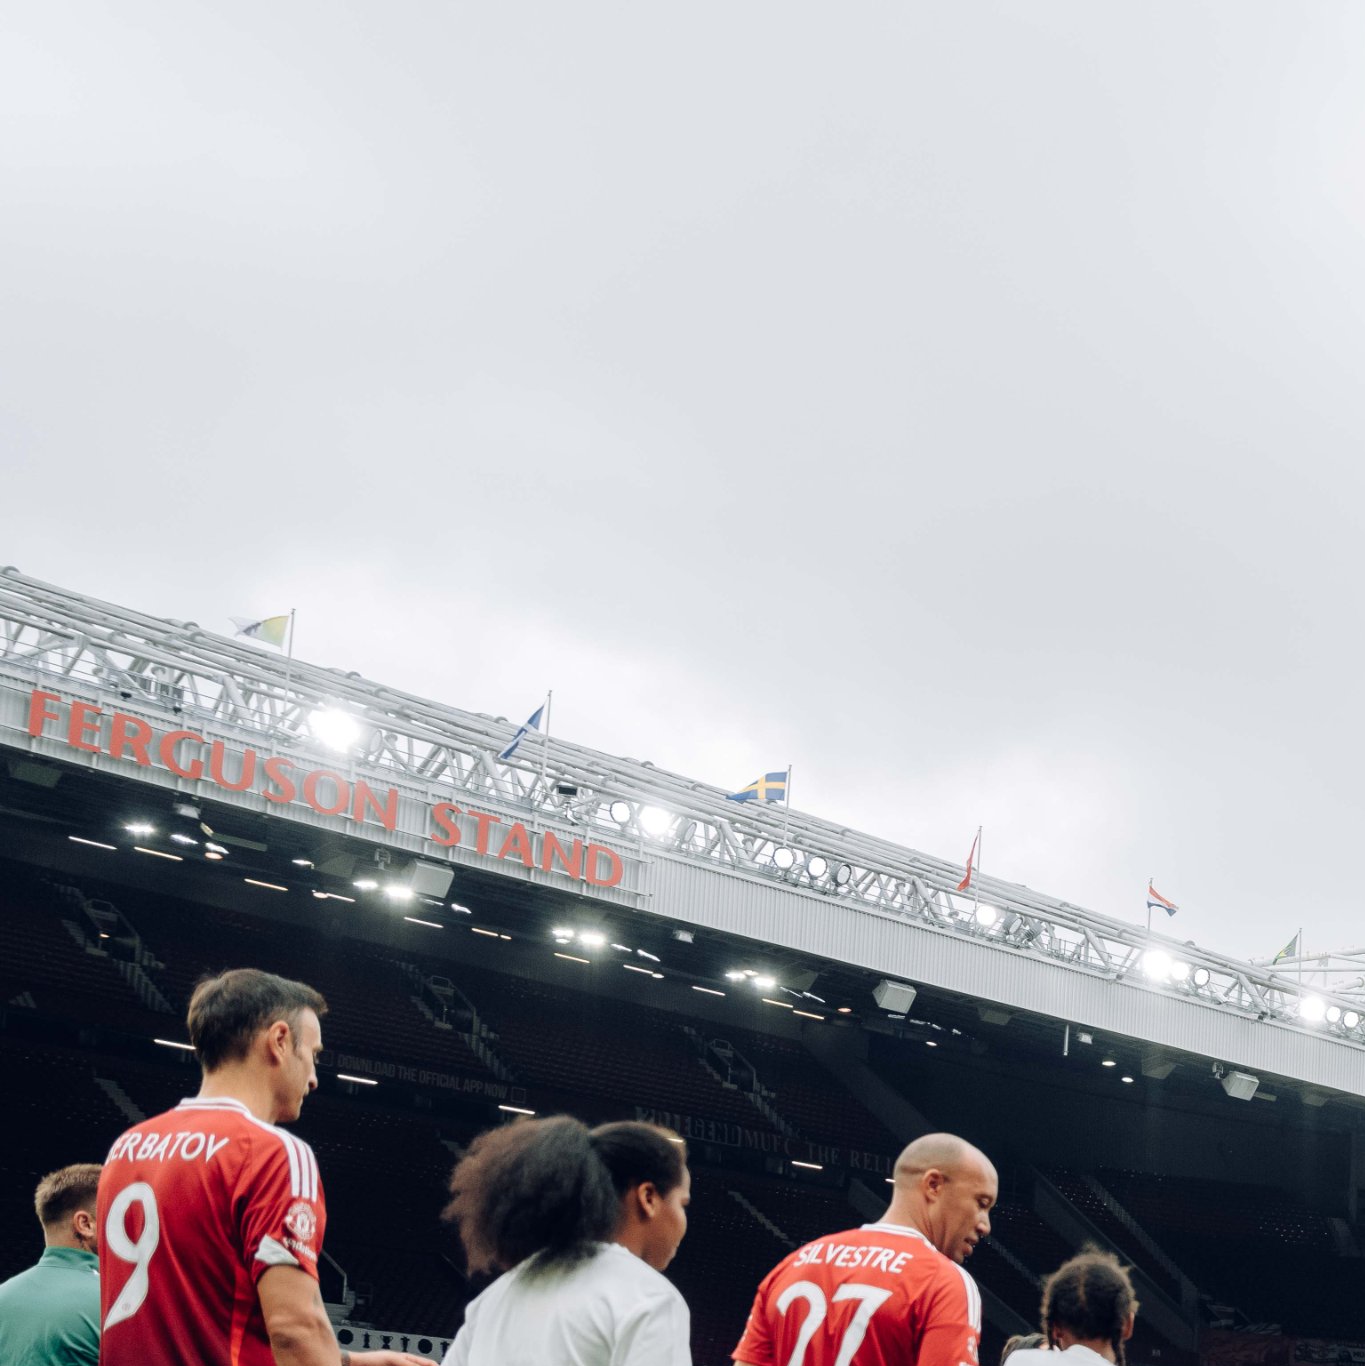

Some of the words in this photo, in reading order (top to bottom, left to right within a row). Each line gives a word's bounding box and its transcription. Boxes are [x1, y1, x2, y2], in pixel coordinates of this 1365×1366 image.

[28, 689, 398, 832] FERGUSON
[430, 801, 625, 888] STAND
[337, 1054, 396, 1078] DOWNLOAD
[398, 1065, 417, 1082] THE
[419, 1070, 461, 1091] OFFICIAL
[463, 1078, 484, 1094] APP
[484, 1082, 509, 1100] NOW
[805, 1142, 841, 1166] THE
[104, 1181, 160, 1333] 9
[793, 1241, 913, 1275] SILVESTRE
